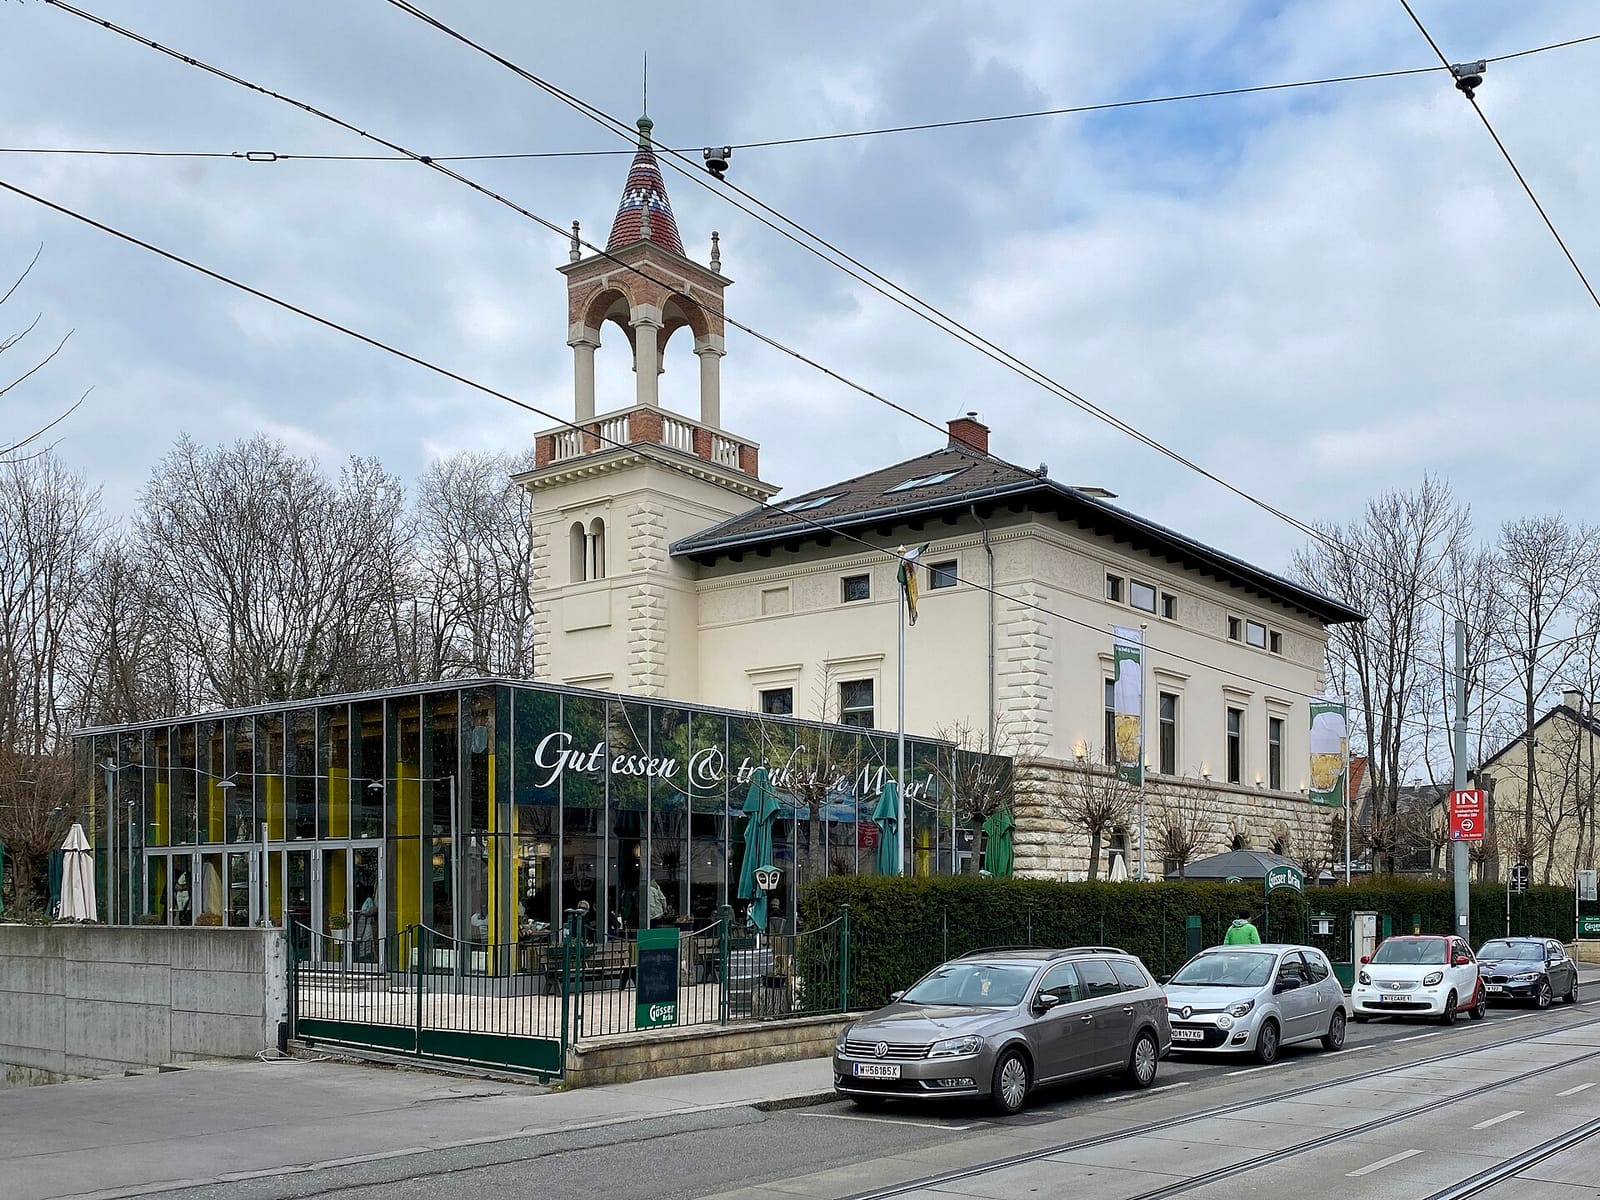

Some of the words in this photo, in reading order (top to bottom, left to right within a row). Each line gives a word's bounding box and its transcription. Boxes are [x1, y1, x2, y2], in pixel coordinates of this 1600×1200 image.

[534, 731, 605, 788] Gut
[611, 754, 681, 778] essen
[688, 744, 725, 789] &
[737, 745, 822, 789] trnken
[852, 763, 934, 799] Mer!
[1456, 792, 1478, 805] IN
[1269, 870, 1287, 888] Gösser
[649, 1004, 675, 1021] Gösser
